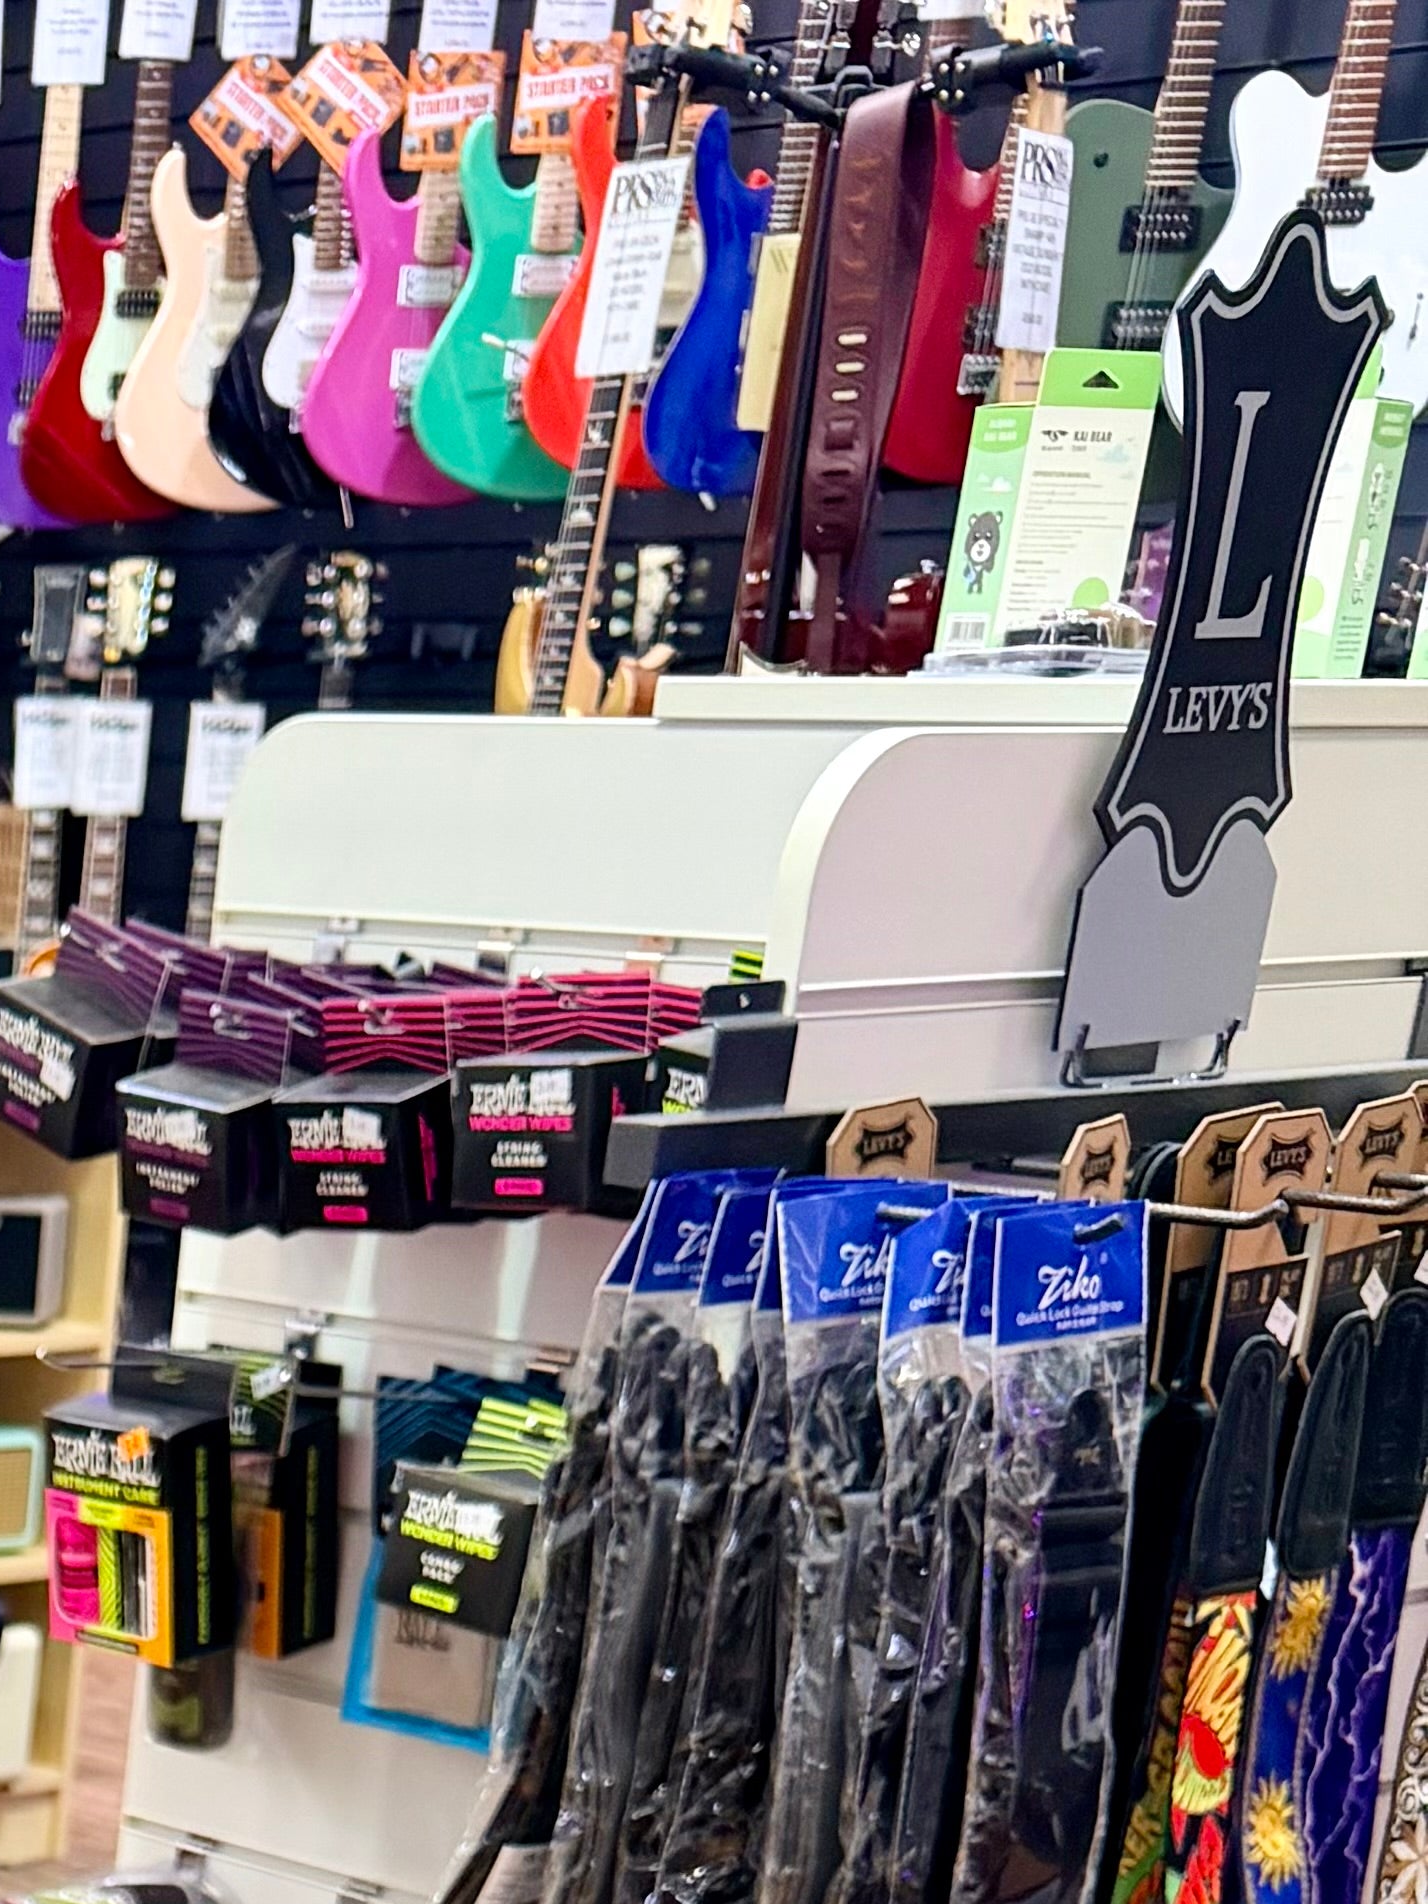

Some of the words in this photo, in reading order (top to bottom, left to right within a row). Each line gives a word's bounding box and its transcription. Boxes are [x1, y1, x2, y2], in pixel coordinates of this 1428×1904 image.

[1195, 391, 1271, 640] L
[1162, 682, 1273, 734] LEVY'S
[469, 1116, 527, 1131] WONDER
[529, 1116, 573, 1131] WIPES
[862, 1131, 907, 1155] LEVY'S
[1268, 1146, 1308, 1169] LEVY'S
[1038, 1254, 1101, 1311] Ziko
[1016, 1310, 1046, 1327] Quick
[1048, 1306, 1071, 1323] Lock
[52, 1430, 109, 1478] ERNIE
[401, 1519, 455, 1549] WONDER
[455, 1533, 502, 1561] WIPES
